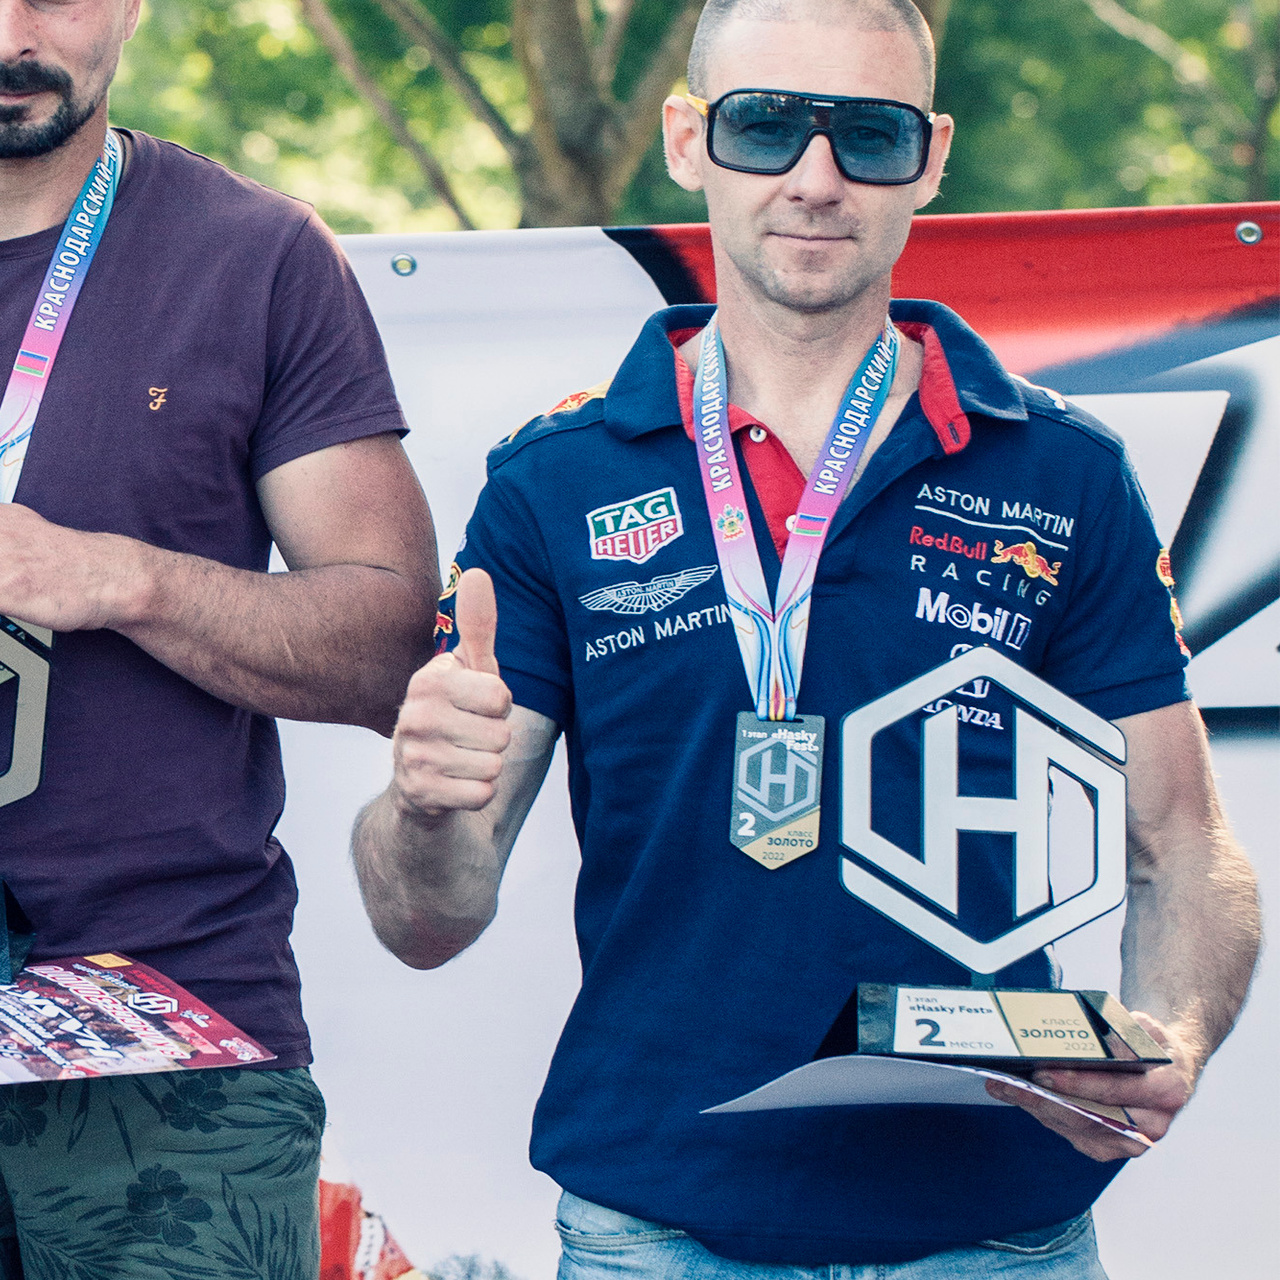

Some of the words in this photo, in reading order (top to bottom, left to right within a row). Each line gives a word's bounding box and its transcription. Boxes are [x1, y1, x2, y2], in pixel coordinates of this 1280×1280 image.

[34, 161, 113, 332] КРАСНОДАРСКИЙ
[813, 341, 894, 495] КРАСНОДАРСКИЙ
[594, 497, 669, 533] TAG
[917, 483, 990, 516] ASTON
[1001, 501, 1074, 537] MARTIN
[597, 522, 675, 559] HEUER
[910, 554, 1051, 605] RACING
[915, 587, 1010, 641] Mobil
[586, 626, 645, 661] ASTON
[737, 812, 756, 837] 2
[762, 851, 785, 861] 2022
[909, 1005, 955, 1014] «Hasky
[959, 1006, 993, 1014] Fest»
[1041, 1018, 1081, 1026] класс
[915, 1018, 946, 1047] 2
[950, 1040, 994, 1049] место
[1064, 1042, 1097, 1051] 2022
